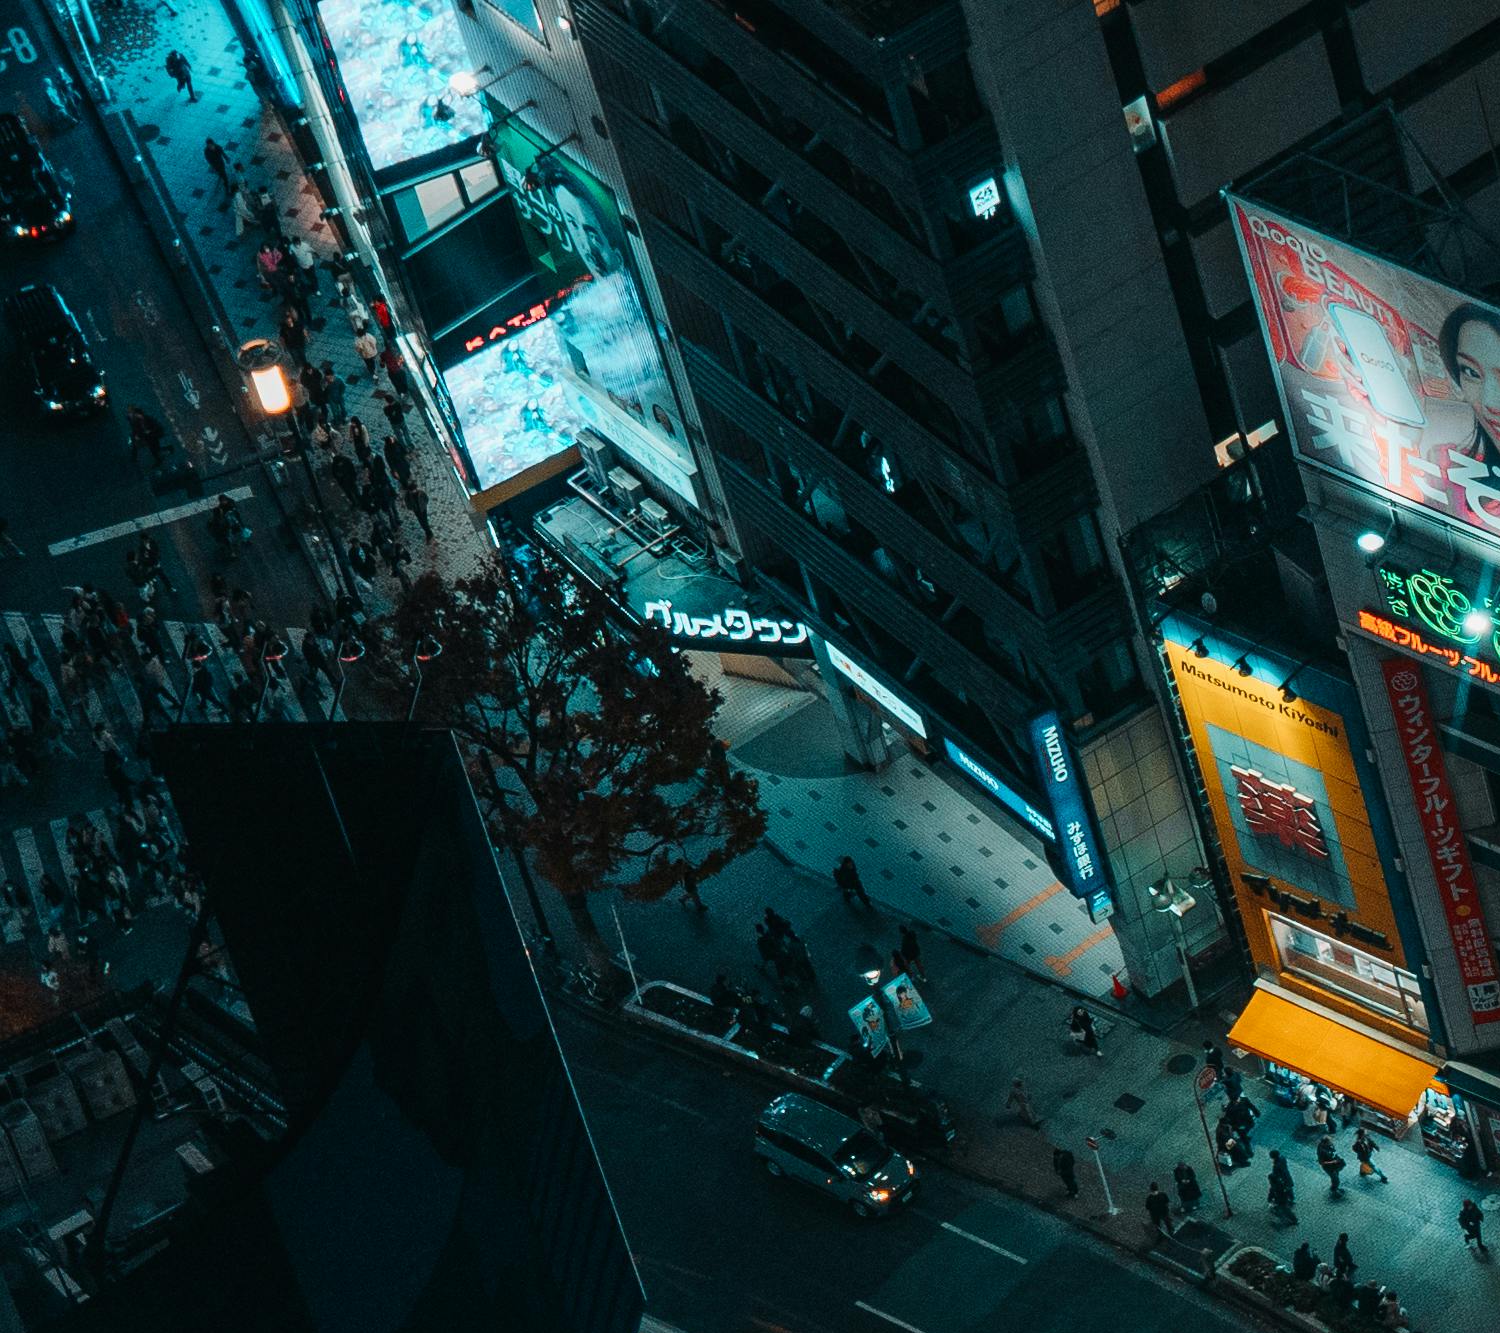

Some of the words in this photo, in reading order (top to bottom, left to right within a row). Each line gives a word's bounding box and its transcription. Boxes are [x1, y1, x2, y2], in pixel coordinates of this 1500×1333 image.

[1249, 215, 1329, 264] Qoo10
[644, 598, 812, 645] グルメタウン
[1180, 660, 1276, 711] Matsumoto
[958, 750, 1000, 792] MIZUHO
[1042, 724, 1069, 784] MIZUHO
[1397, 694, 1472, 902] ウィンターフルーツギフト
[1066, 821, 1096, 881] みずほ銀行
